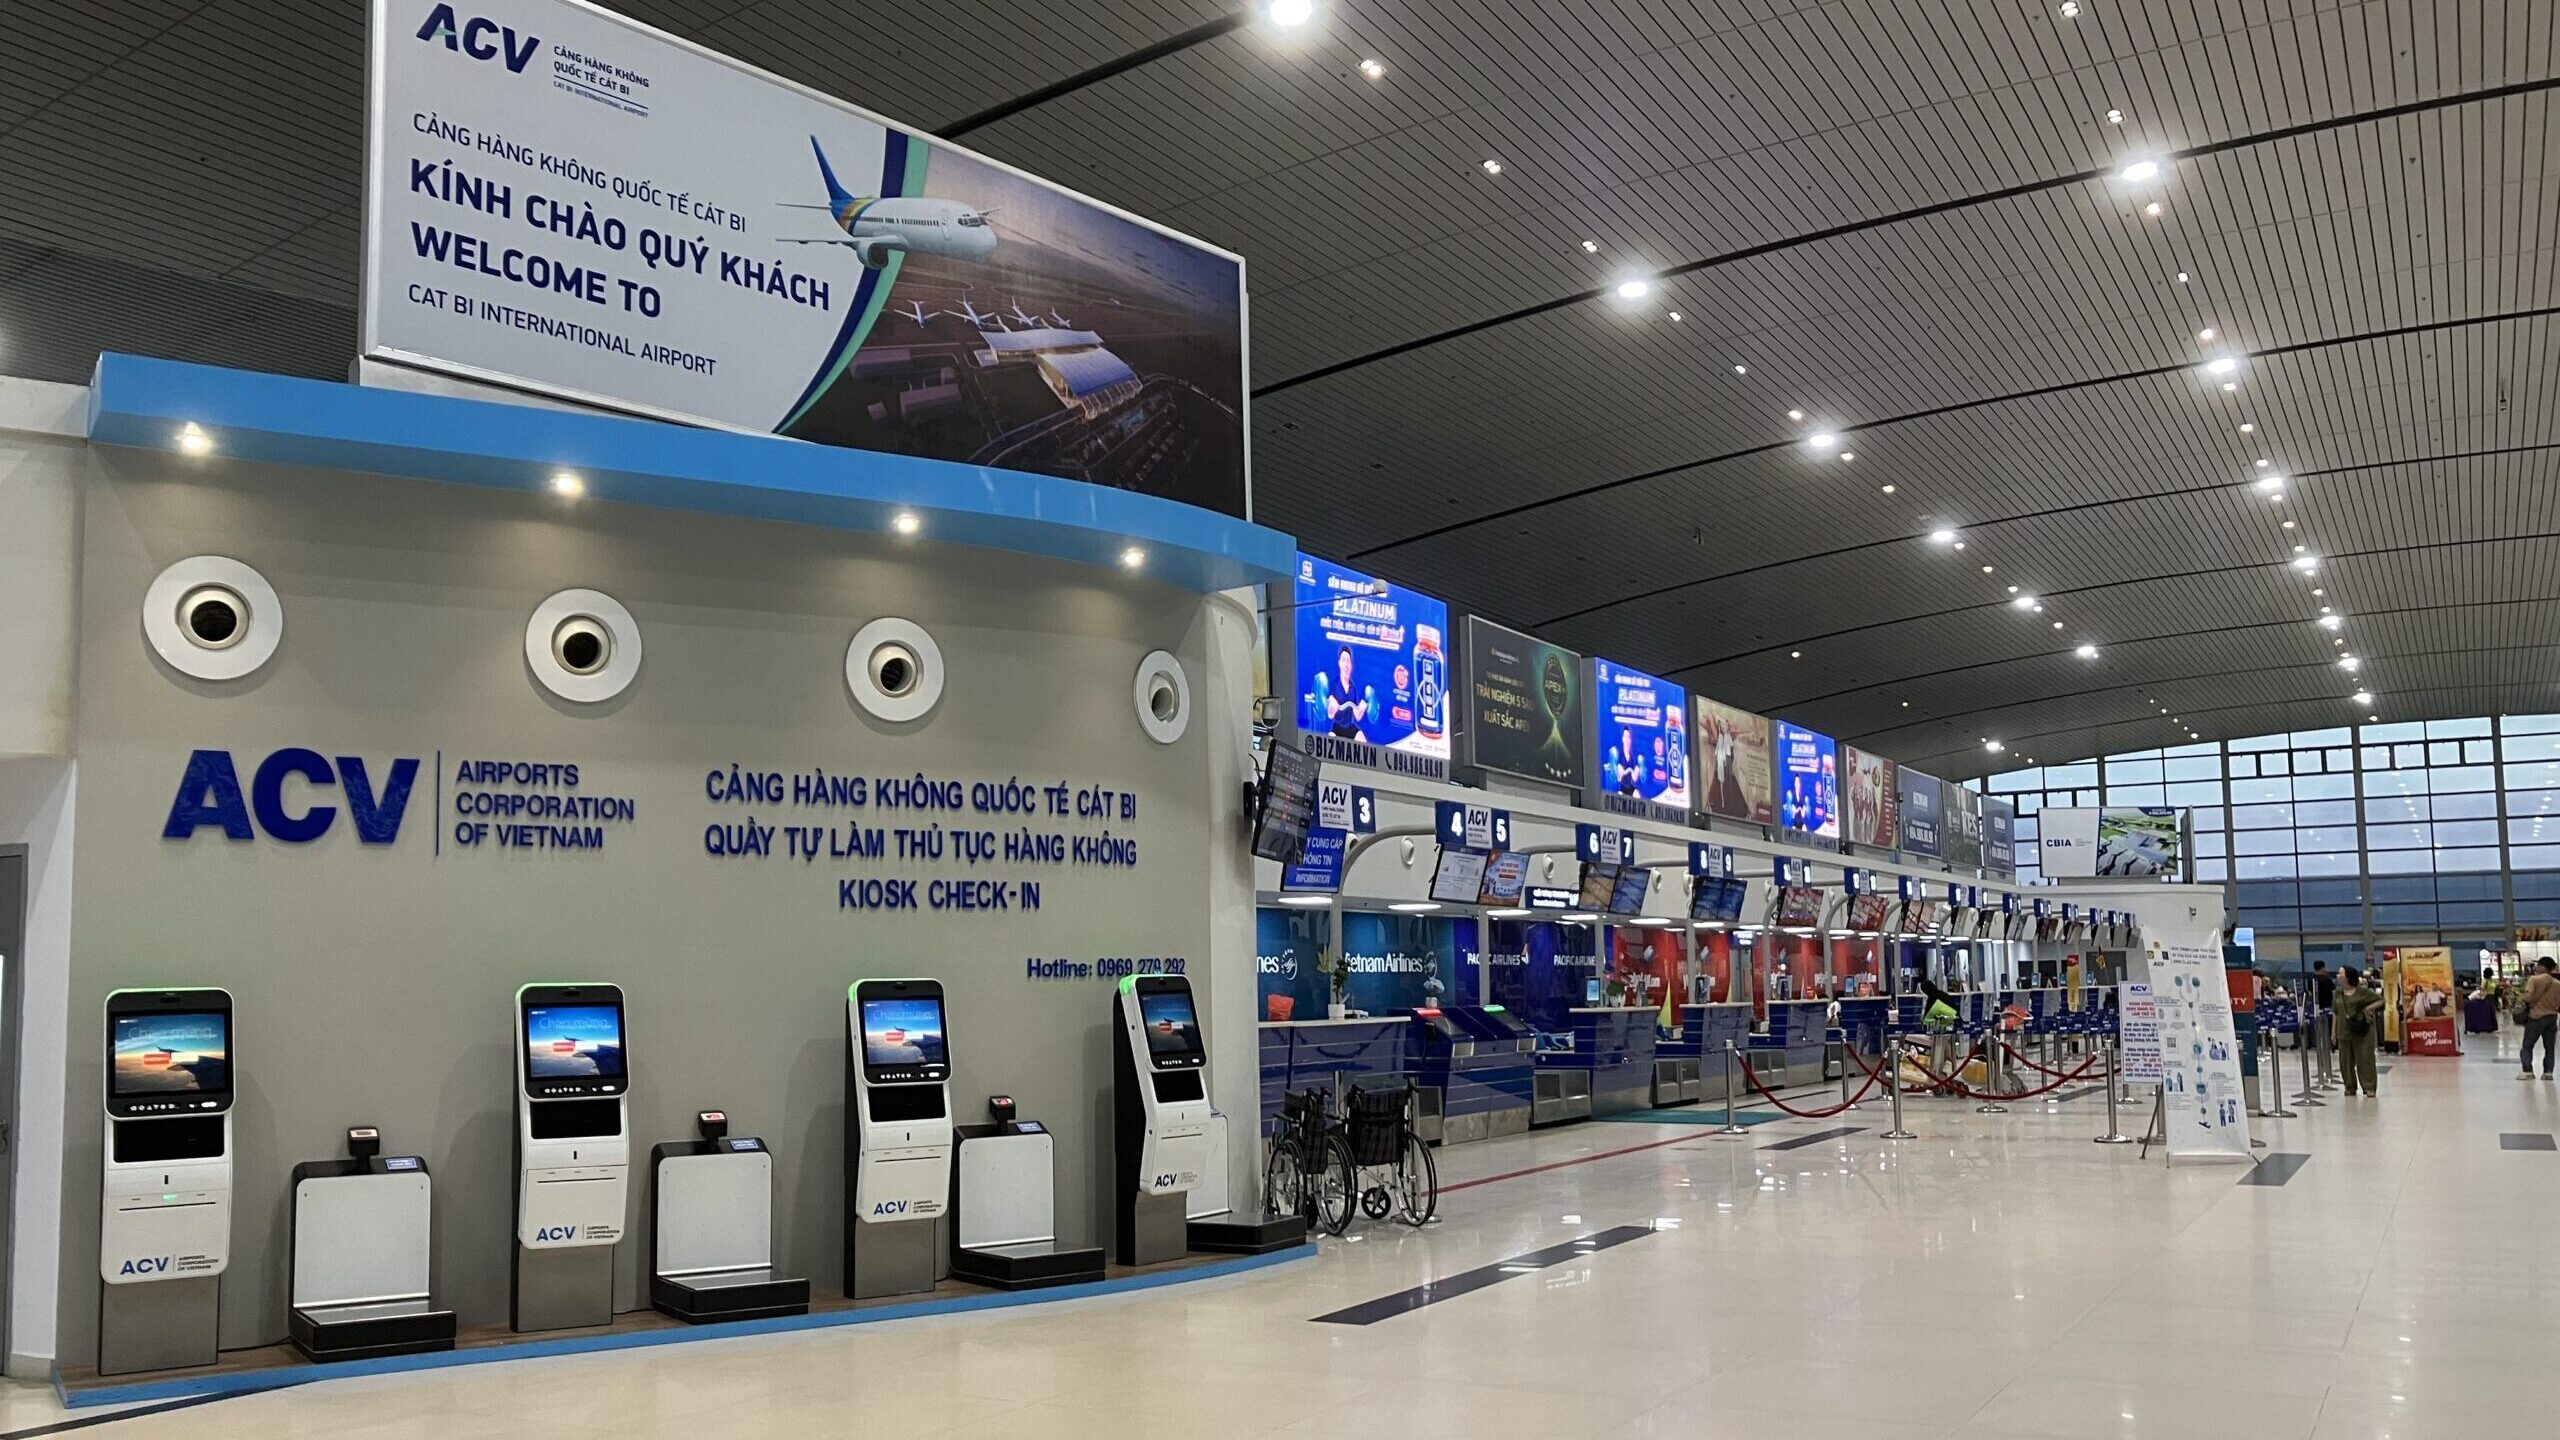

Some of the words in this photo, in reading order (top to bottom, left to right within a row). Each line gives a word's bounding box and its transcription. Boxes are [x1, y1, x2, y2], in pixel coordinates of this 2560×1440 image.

[416, 2, 541, 74] ACV
[554, 61, 582, 79] QUỐC
[620, 84, 630, 95] BI
[615, 68, 649, 88] KHÔNG
[413, 112, 471, 146] CẢNG
[477, 132, 534, 166] HÀNG
[540, 152, 606, 188] KHÔNG
[612, 177, 662, 207] QUỐC
[667, 192, 689, 215] TẾ
[694, 202, 725, 226] CÁT
[730, 213, 746, 233] BI
[411, 158, 511, 220] KÍNH
[526, 194, 626, 251] CHÀO
[639, 228, 709, 275] QUÝ
[720, 251, 829, 311] KHÁCH
[411, 221, 607, 305] WELCOME
[617, 279, 661, 318] TO
[409, 284, 448, 309] CAT
[454, 295, 473, 316] BI
[481, 301, 636, 357] INTERNATIONAL
[641, 343, 717, 376] AIRPORT
[1334, 595, 1396, 622] PLATINUM
[457, 760, 579, 786] AIRPORTS
[163, 747, 420, 844] ACV
[706, 763, 784, 803] CẢNG
[793, 768, 868, 806] HÀNG
[875, 773, 964, 810] KHÔNG
[972, 776, 1036, 813] QUỐC
[1044, 780, 1069, 815] TẾ
[1077, 784, 1114, 818] CÁT
[1120, 793, 1136, 820] BI
[1321, 785, 1348, 806] ACV
[456, 792, 634, 820] CORPORATION
[1358, 796, 1371, 824] 3
[1467, 809, 1489, 827] ACV
[455, 822, 489, 846] OF
[497, 824, 603, 849] VIETNAM
[1451, 811, 1463, 837] 4
[1496, 818, 1507, 842] 5
[784, 827, 823, 863] TỰ
[830, 821, 885, 858] LÀM
[893, 822, 943, 859] THỦ
[950, 831, 996, 864] TỤC
[1005, 826, 1065, 862] HÀNG
[1073, 830, 1137, 866] KHÔNG
[1589, 832, 1598, 854] 6
[1601, 830, 1618, 846] ACV
[1623, 836, 1632, 858] 7
[2046, 839, 2072, 848] CBIA
[1303, 853, 1321, 866] HÔNG
[1700, 849, 1708, 869] 8
[1725, 853, 1732, 872] 9
[839, 879, 918, 909] KIOSK
[928, 880, 1040, 909] CHECK-IN
[1027, 958, 1093, 978] Hotline:
[1097, 958, 1133, 977] 0969
[1164, 958, 1186, 975] 292
[1575, 955, 1596, 966] AIRLINE
[1154, 1173, 1178, 1188] ACV
[873, 1200, 908, 1215] ACV
[536, 1225, 576, 1242] ACV
[120, 1256, 169, 1276] ACV
